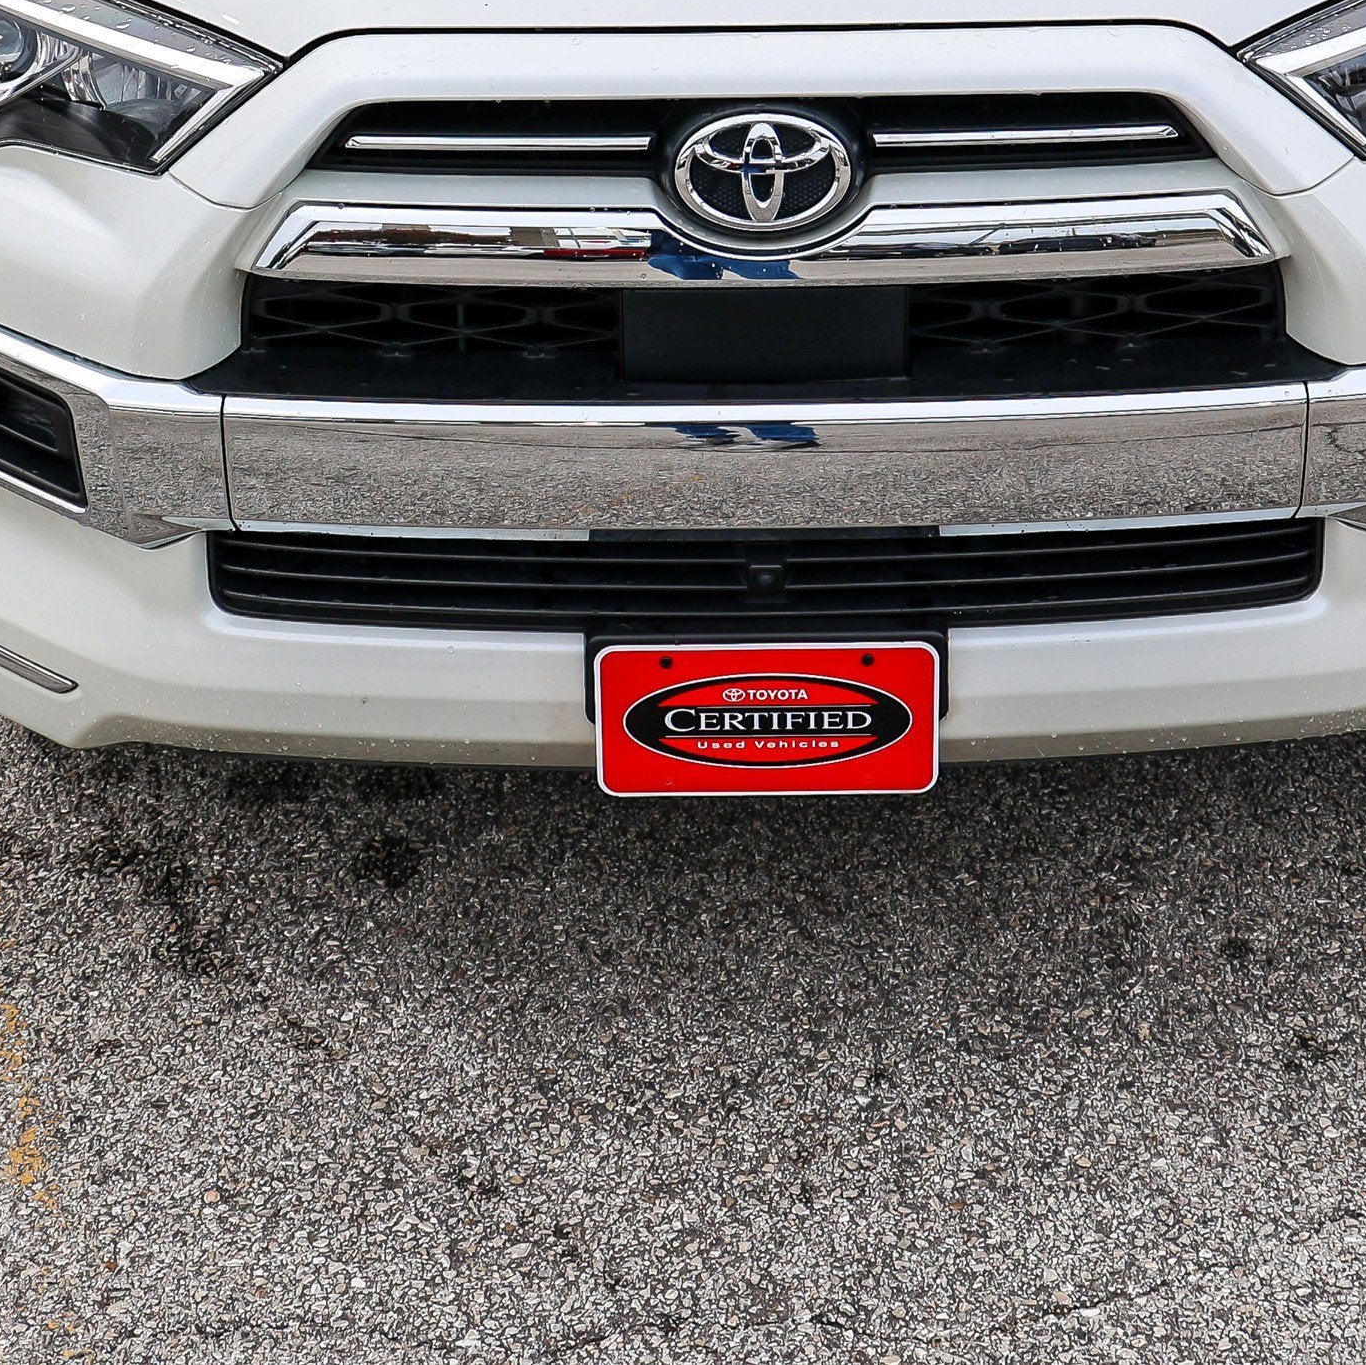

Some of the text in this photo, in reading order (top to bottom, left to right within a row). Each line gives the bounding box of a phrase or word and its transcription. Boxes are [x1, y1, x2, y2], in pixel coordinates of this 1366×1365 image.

[747, 689, 808, 701] TOYOTA
[664, 708, 872, 732] CERTIFIED
[697, 740, 839, 750] Used Vehicles
